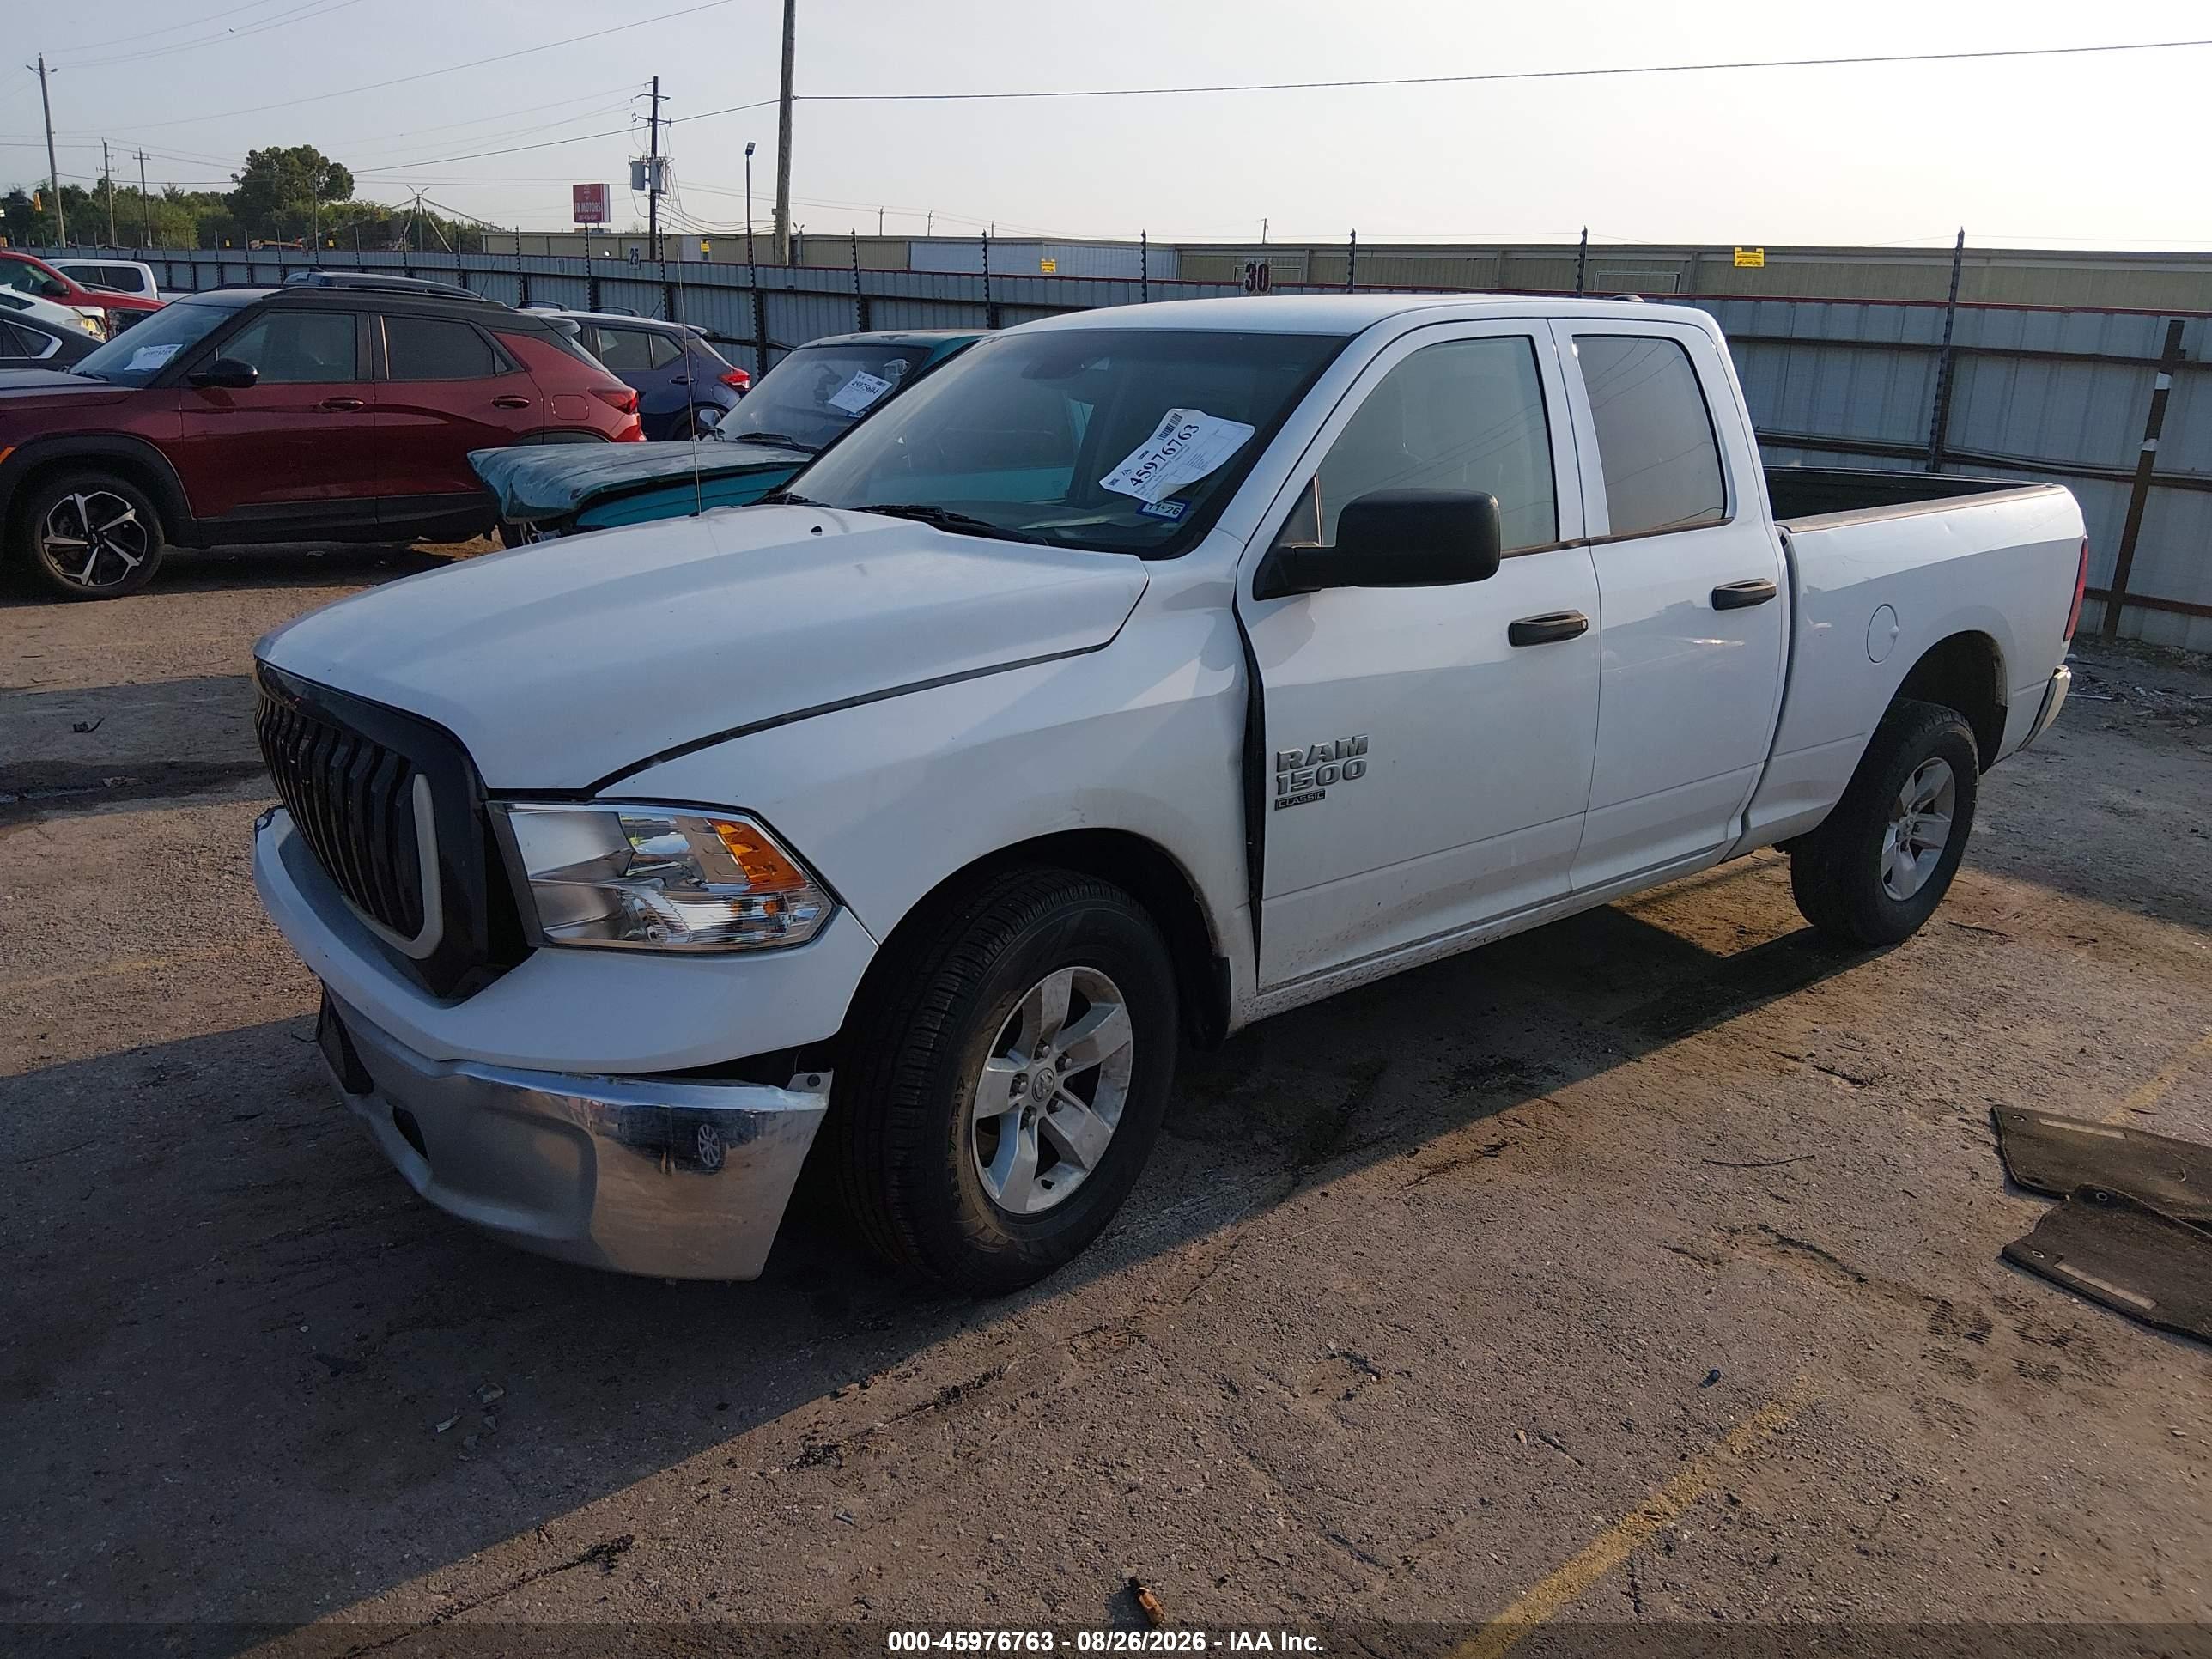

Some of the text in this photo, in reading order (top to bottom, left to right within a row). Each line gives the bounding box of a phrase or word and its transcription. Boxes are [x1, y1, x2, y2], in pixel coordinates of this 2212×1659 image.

[629, 247, 639, 265] 25
[1245, 263, 1269, 291] 30
[1130, 424, 1200, 488] 45976763
[1277, 734, 1368, 772] RAM
[1277, 757, 1368, 795] 1500
[1278, 789, 1325, 809] CLASSIC
